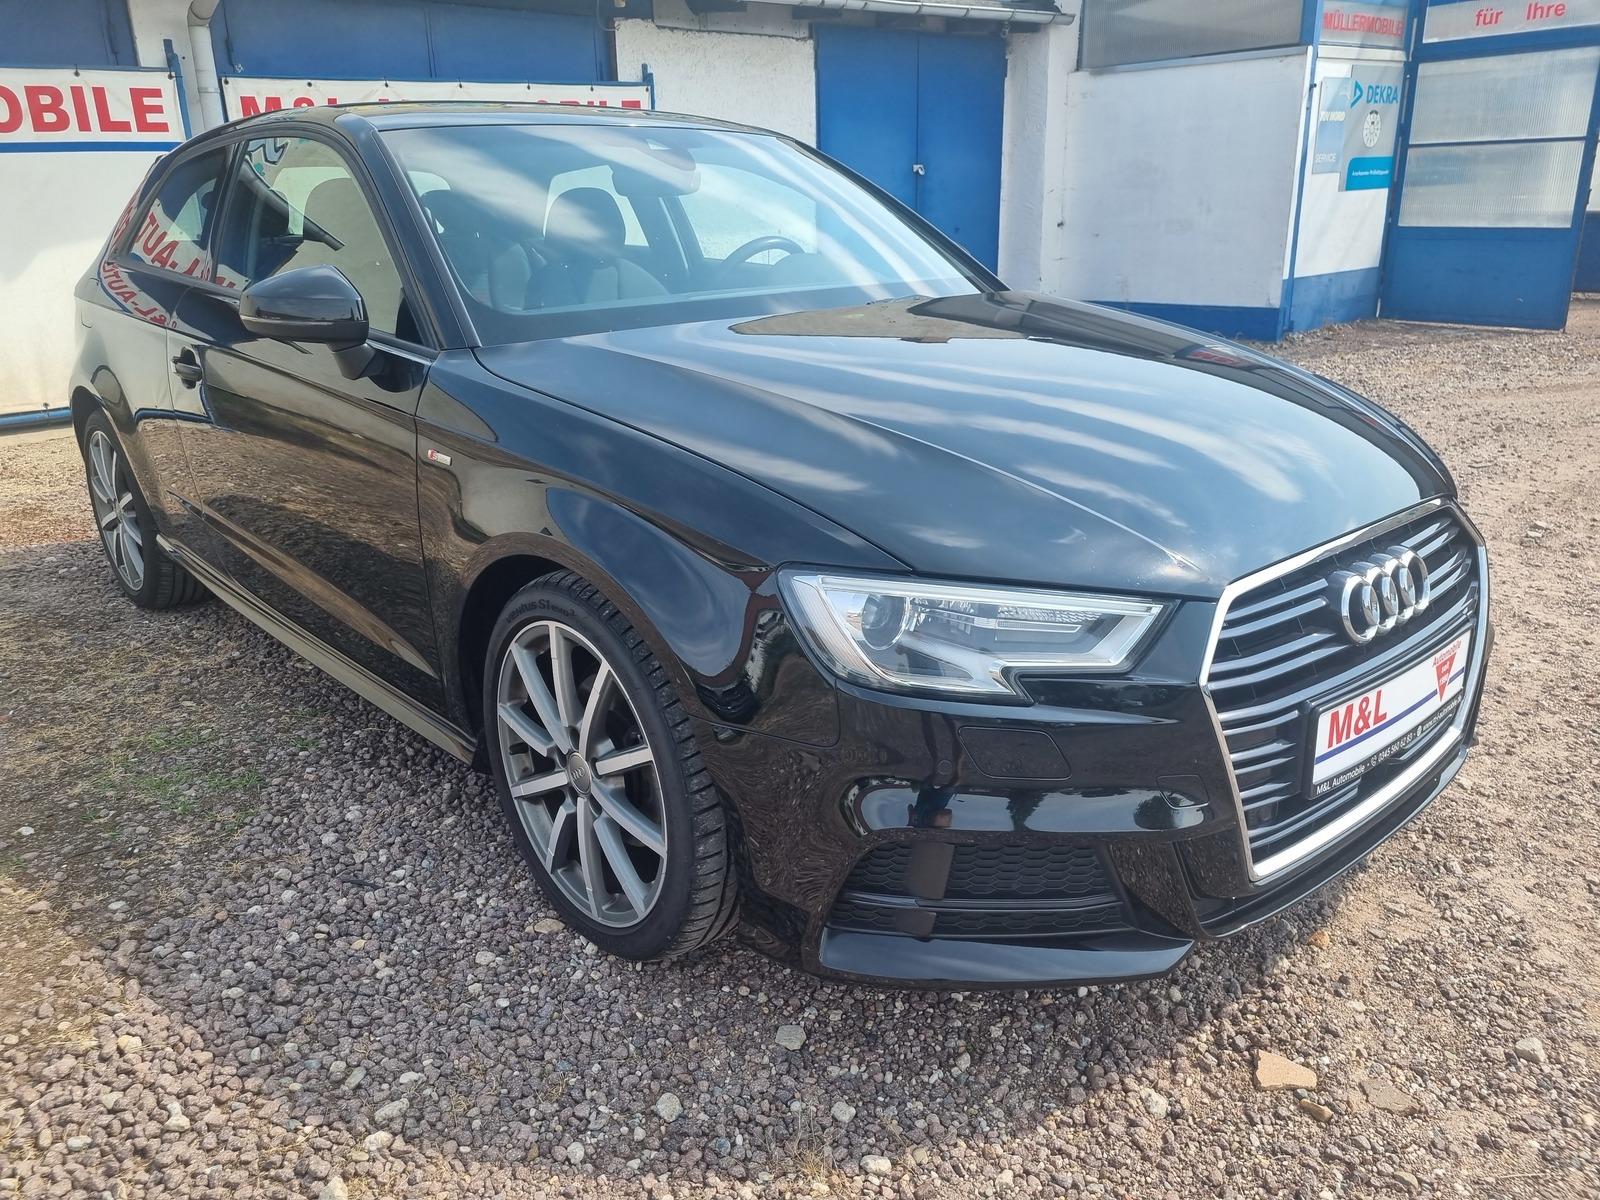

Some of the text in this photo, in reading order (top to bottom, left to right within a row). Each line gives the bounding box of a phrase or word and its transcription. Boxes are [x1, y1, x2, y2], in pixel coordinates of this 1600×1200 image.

[1475, 2, 1566, 26] für Ihre
[1366, 84, 1398, 105] DEKRA
[1327, 689, 1388, 749] M&L
[1316, 783, 1332, 795] M&L
[1331, 763, 1366, 787] Automobile
